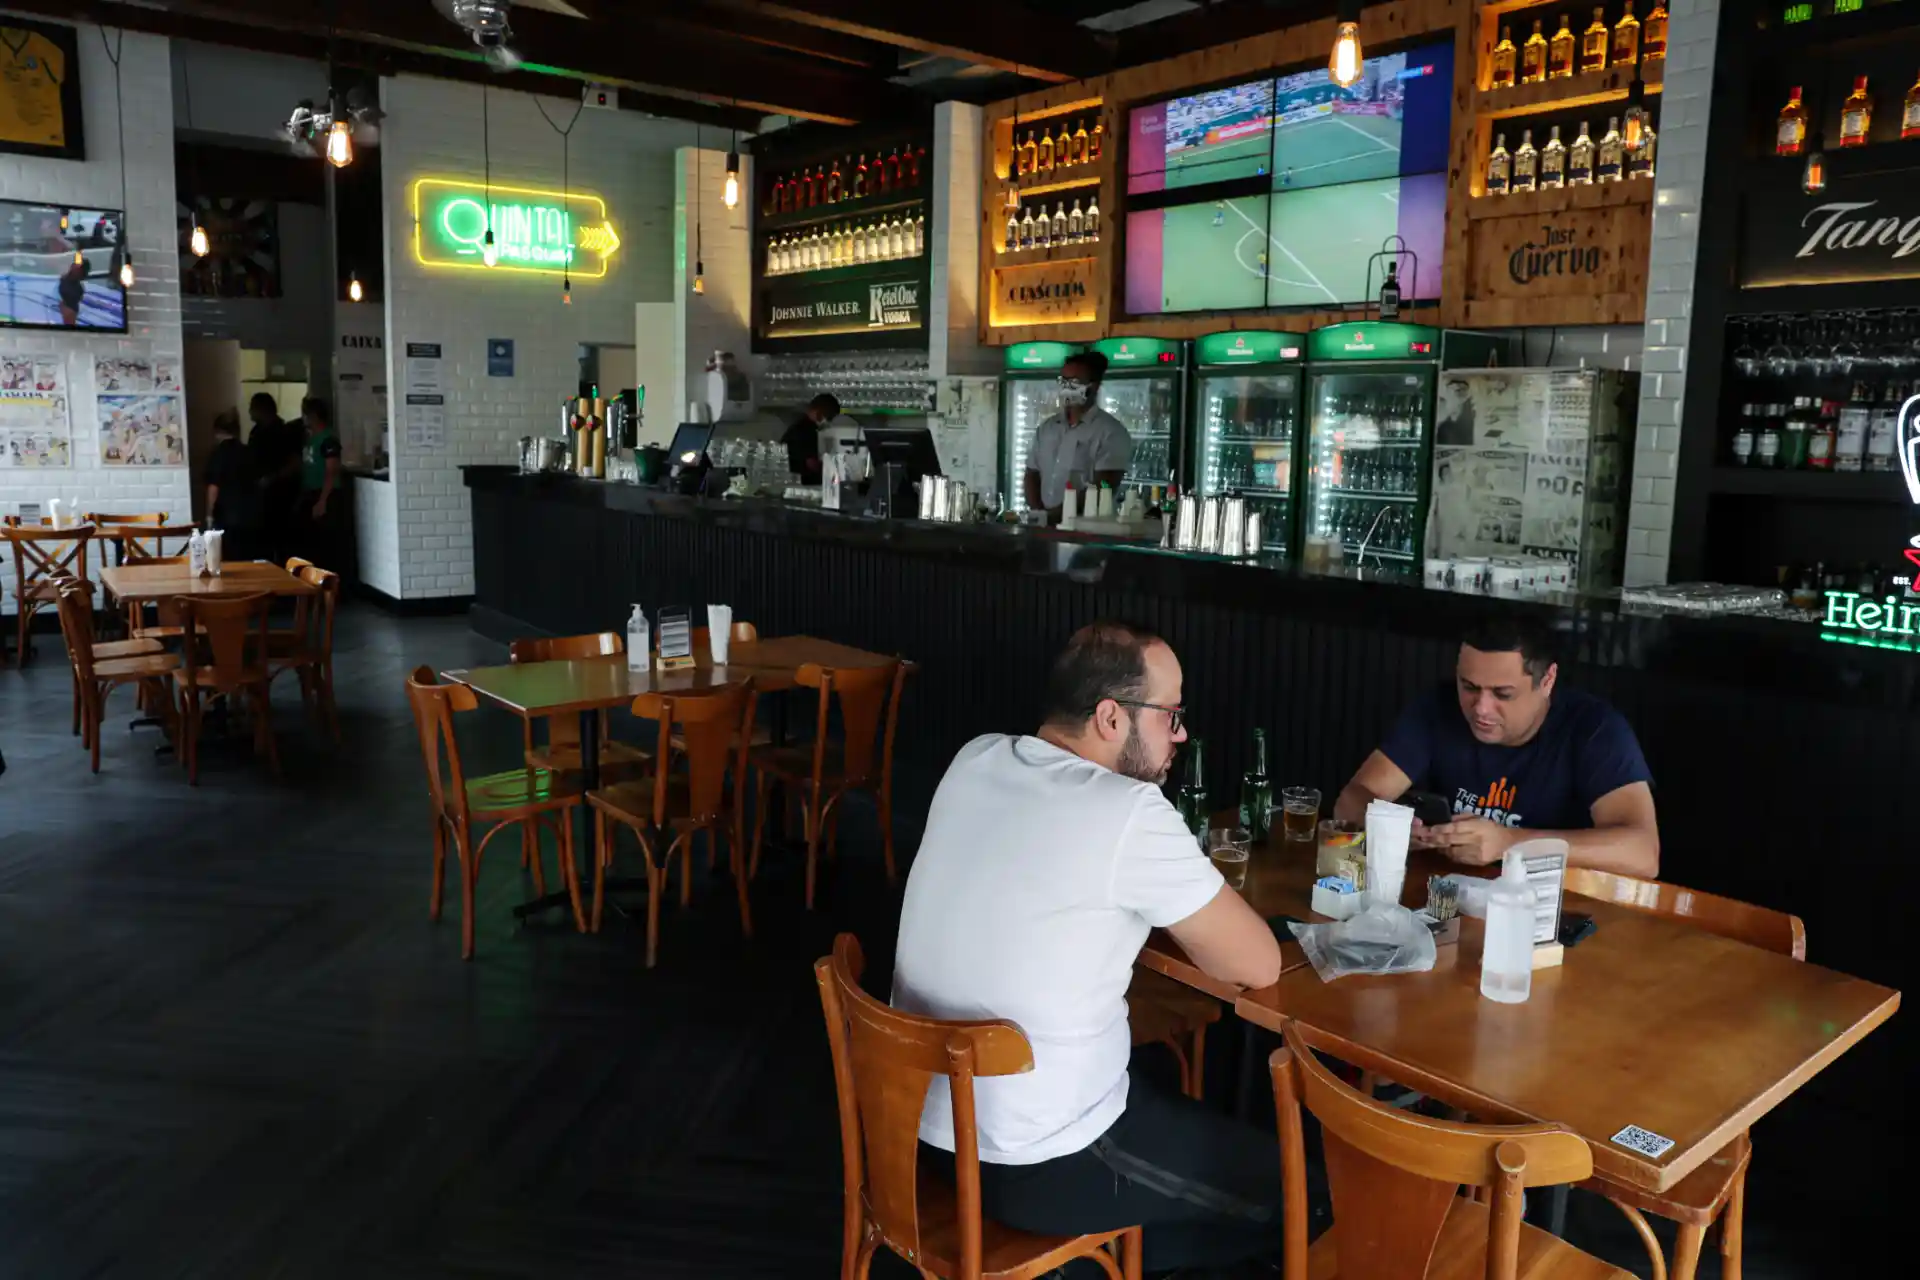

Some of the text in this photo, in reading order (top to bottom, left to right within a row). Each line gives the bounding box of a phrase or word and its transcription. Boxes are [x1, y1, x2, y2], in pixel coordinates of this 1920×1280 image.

[1509, 241, 1600, 285] Cuervo
[770, 301, 860, 325] JOHNNIE WALKER
[341, 335, 382, 349] CAIXA
[1456, 787, 1479, 806] THE
